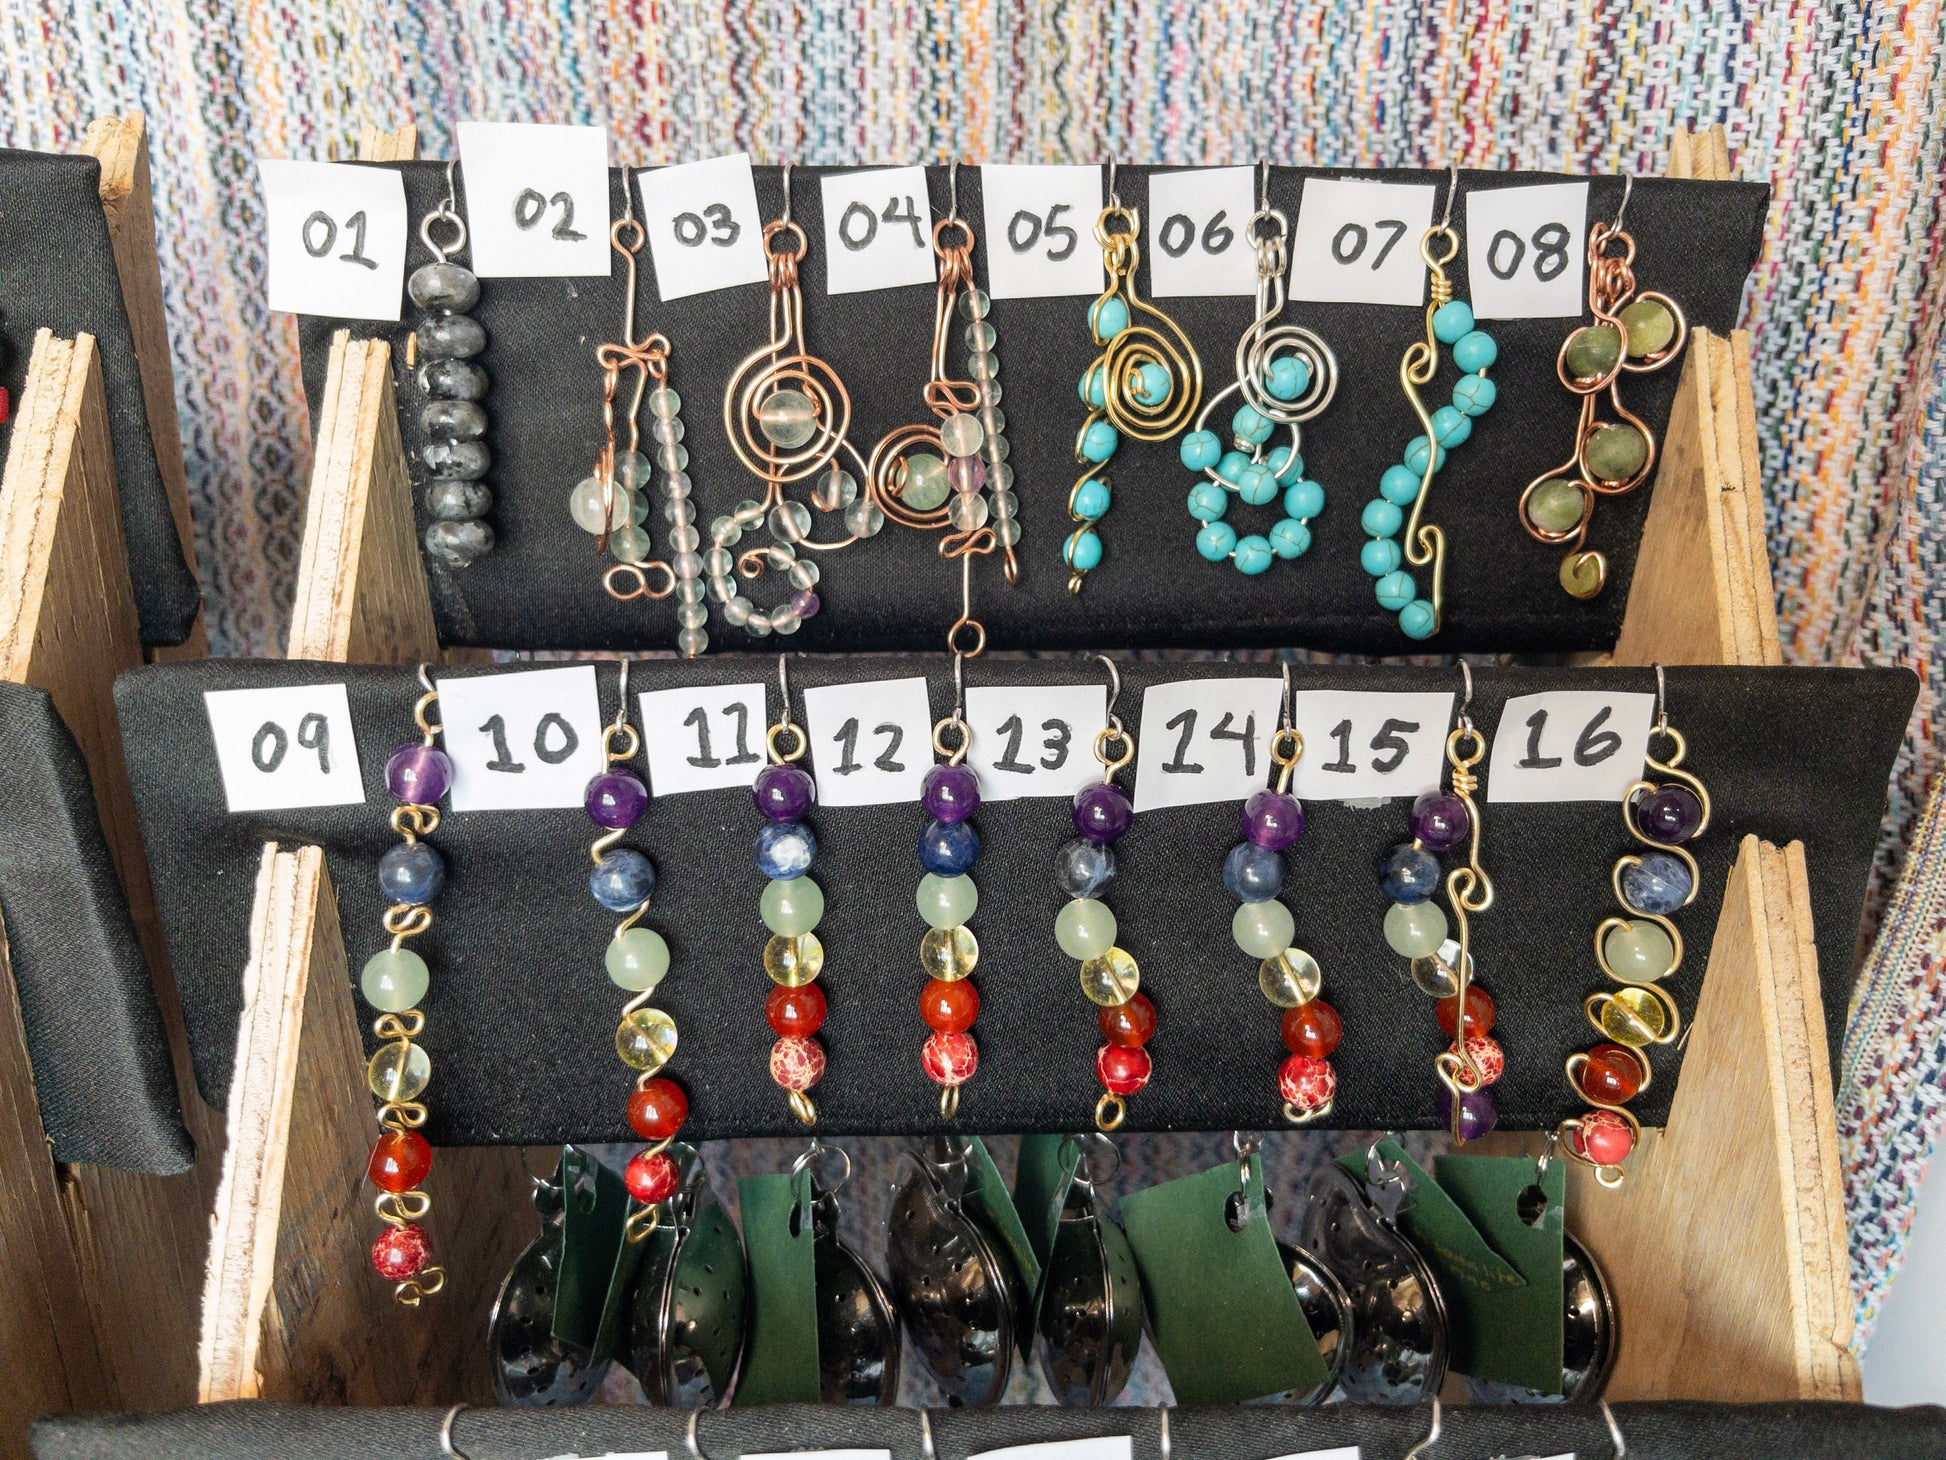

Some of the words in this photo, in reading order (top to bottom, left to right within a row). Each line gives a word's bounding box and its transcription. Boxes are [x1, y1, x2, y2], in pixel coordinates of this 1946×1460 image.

[303, 212, 378, 269] 01
[514, 188, 587, 239] 02
[672, 203, 741, 246] 03
[839, 196, 928, 251] 04
[1008, 204, 1078, 262] 05
[1158, 210, 1235, 258] 06
[1330, 219, 1409, 271] 07
[1485, 221, 1569, 283] 08
[251, 712, 330, 775] 09
[478, 712, 579, 773] 10
[682, 702, 761, 769] 11
[831, 717, 907, 776] 12
[992, 714, 1073, 775] 13
[1161, 708, 1258, 777] 14
[1321, 718, 1421, 774] 15
[1519, 705, 1622, 770] 16
